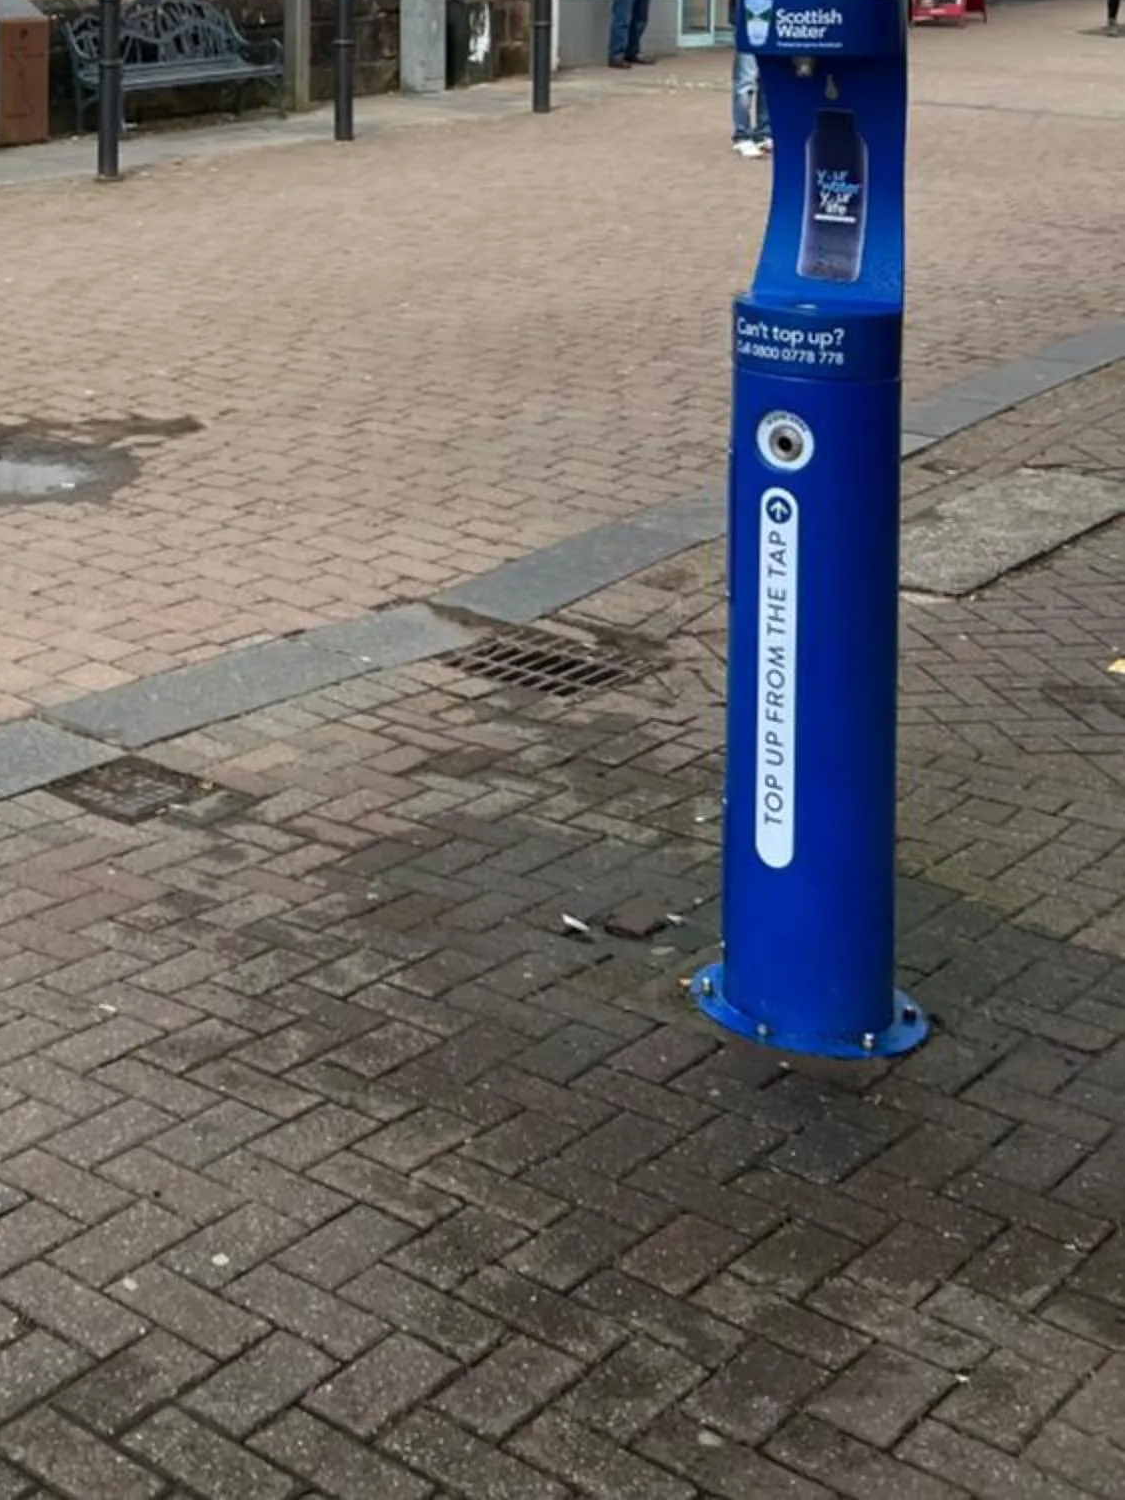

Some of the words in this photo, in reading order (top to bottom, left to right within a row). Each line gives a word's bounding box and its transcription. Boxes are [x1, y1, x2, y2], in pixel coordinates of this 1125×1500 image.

[776, 8, 843, 25] Scottish
[776, 21, 828, 39] Water
[737, 316, 769, 340] Can't
[772, 325, 805, 348] top
[807, 327, 846, 350] up?
[818, 351, 844, 366] 778
[767, 530, 788, 579] TAP
[766, 586, 787, 637] THE
[765, 646, 786, 725] FROM
[764, 730, 785, 767] UP
[763, 774, 785, 826] TOP
